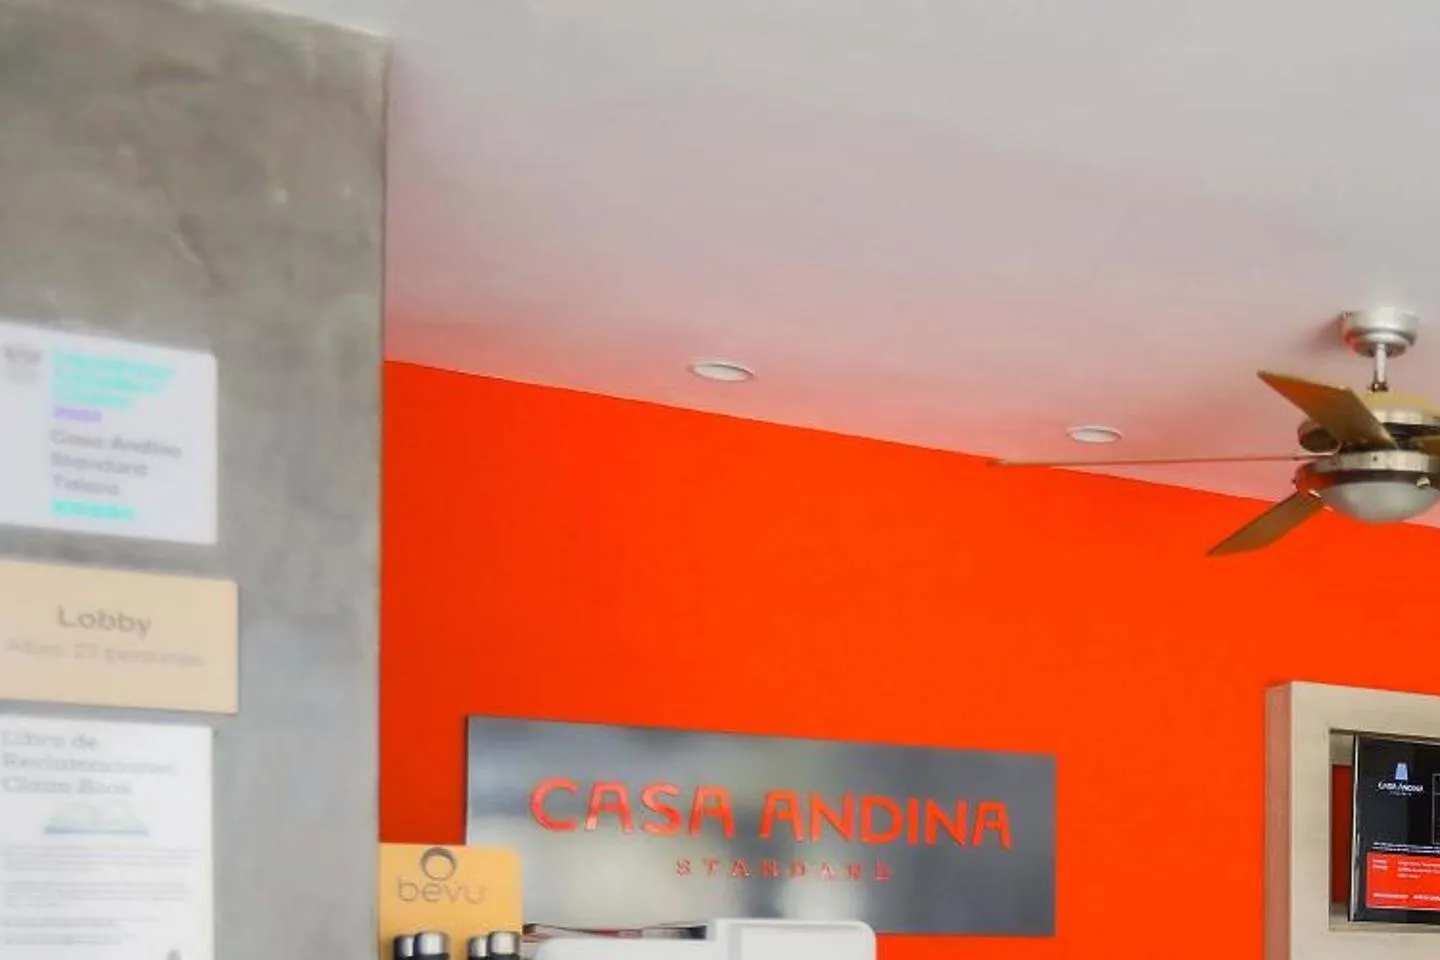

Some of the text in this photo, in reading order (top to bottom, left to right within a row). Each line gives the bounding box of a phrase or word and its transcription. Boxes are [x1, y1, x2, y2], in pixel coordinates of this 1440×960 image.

[55, 603, 153, 641] Lobby
[529, 776, 1013, 851] CASA ANDINA
[675, 859, 893, 883] STANDARD
[397, 877, 486, 905] bevu
